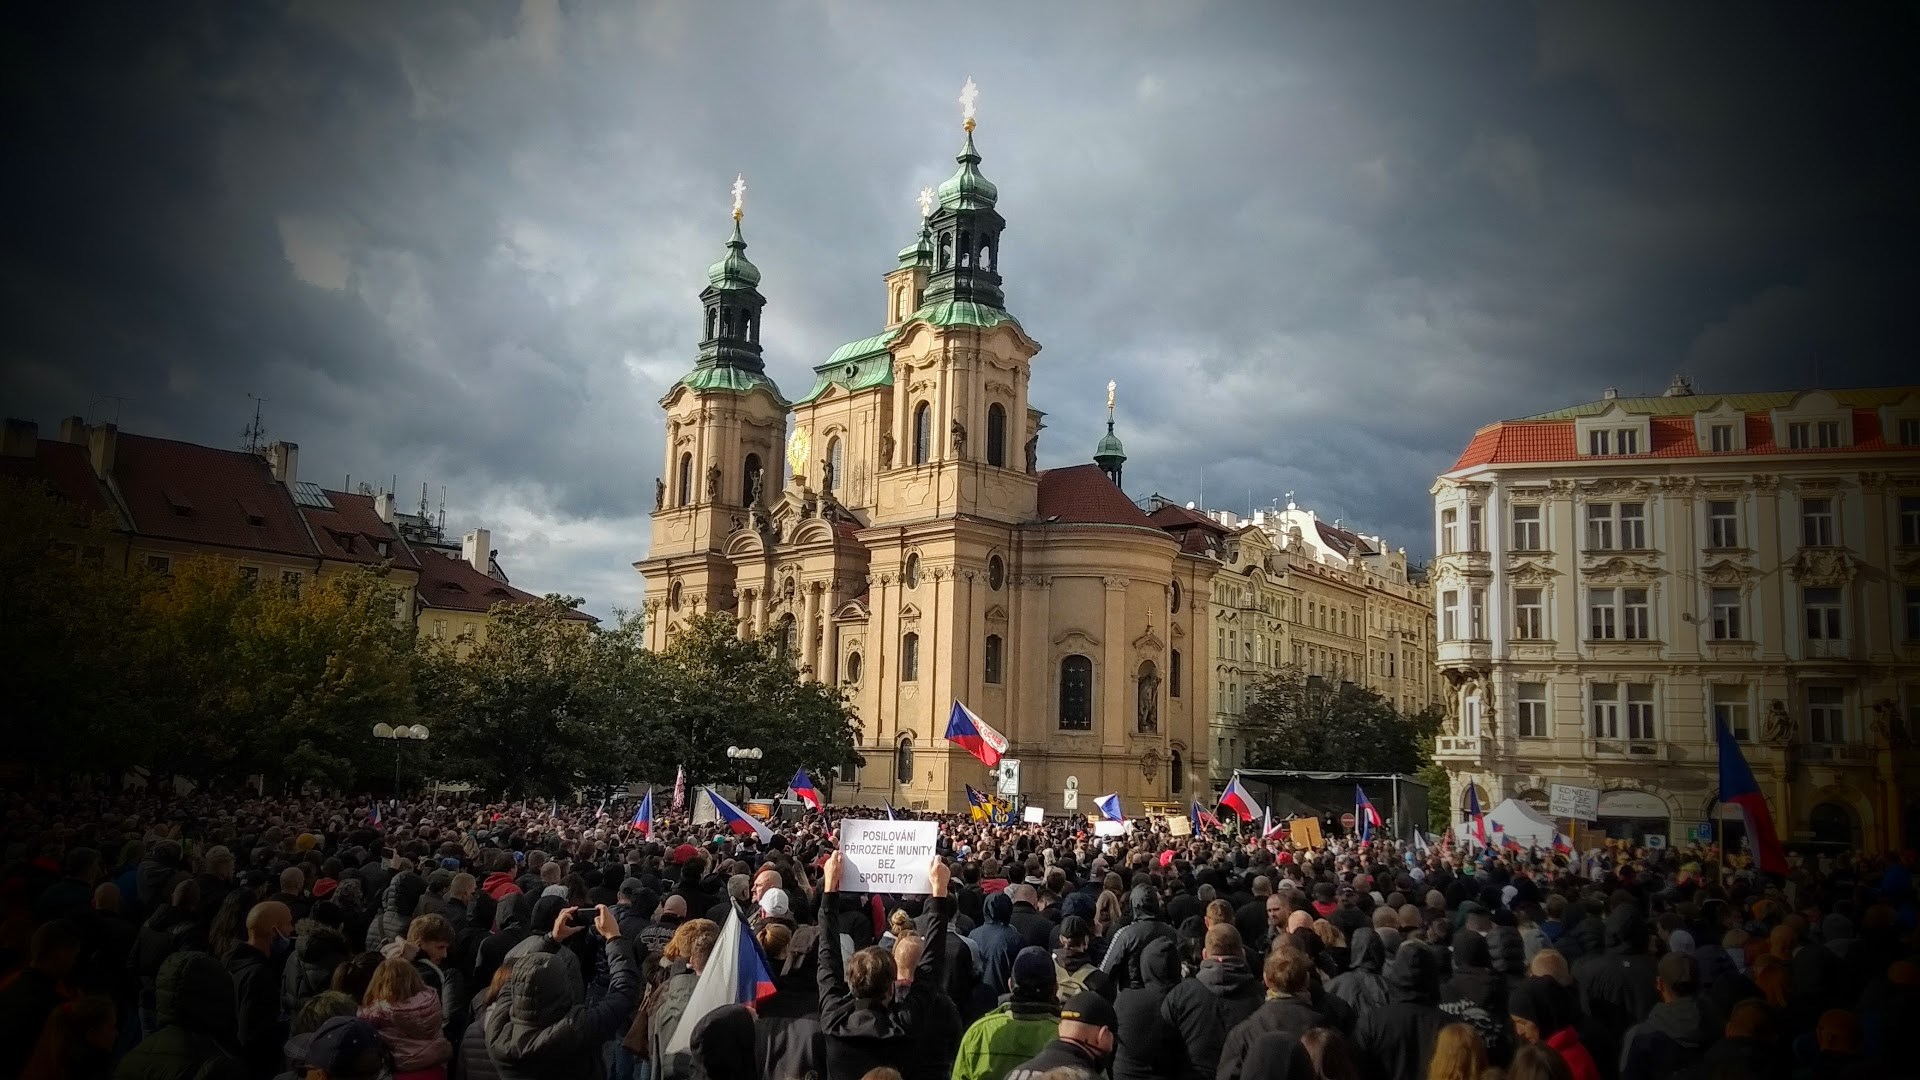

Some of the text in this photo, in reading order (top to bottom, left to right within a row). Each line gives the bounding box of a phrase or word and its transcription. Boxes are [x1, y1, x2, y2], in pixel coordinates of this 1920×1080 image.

[862, 829, 916, 842] POSILOVÁNÍ
[844, 842, 932, 856] PŘIROZENÉ IMUNITY
[878, 859, 895, 869] BEZ
[859, 872, 914, 884] SPORTU ???
